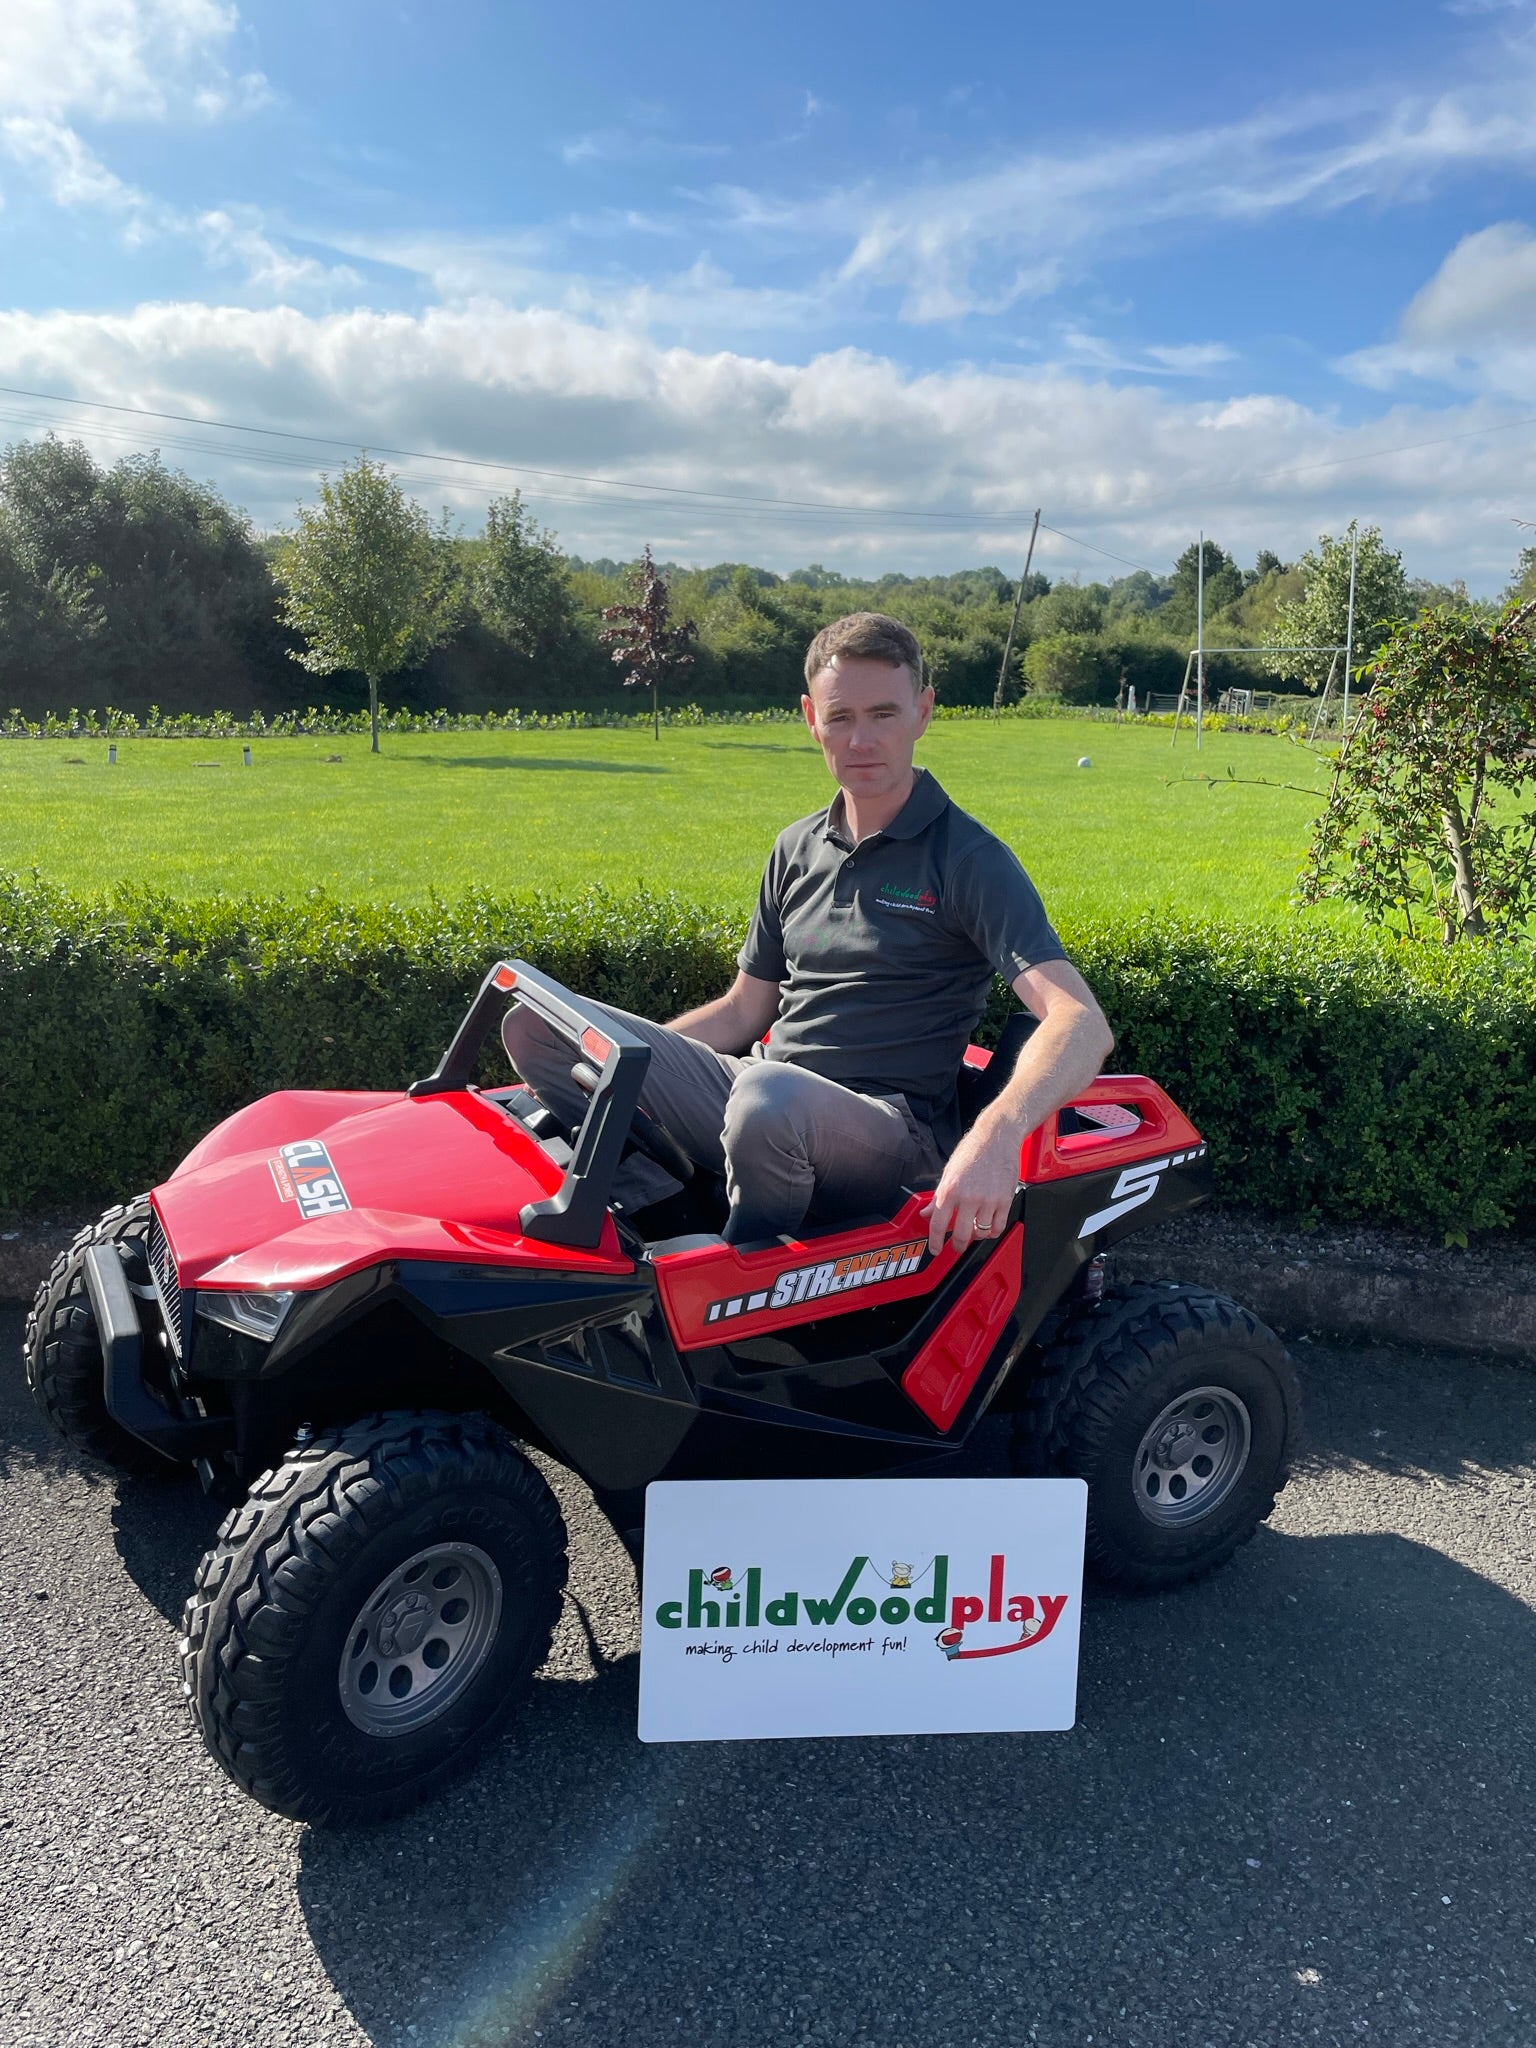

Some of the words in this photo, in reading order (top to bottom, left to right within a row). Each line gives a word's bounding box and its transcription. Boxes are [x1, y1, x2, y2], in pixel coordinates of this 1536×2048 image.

[283, 1141, 347, 1217] CLASH
[771, 1239, 928, 1309] STRENGTH
[686, 1641, 737, 1663] making
[743, 1639, 778, 1654] child
[787, 1637, 875, 1658] development
[882, 1636, 907, 1656] fun!
